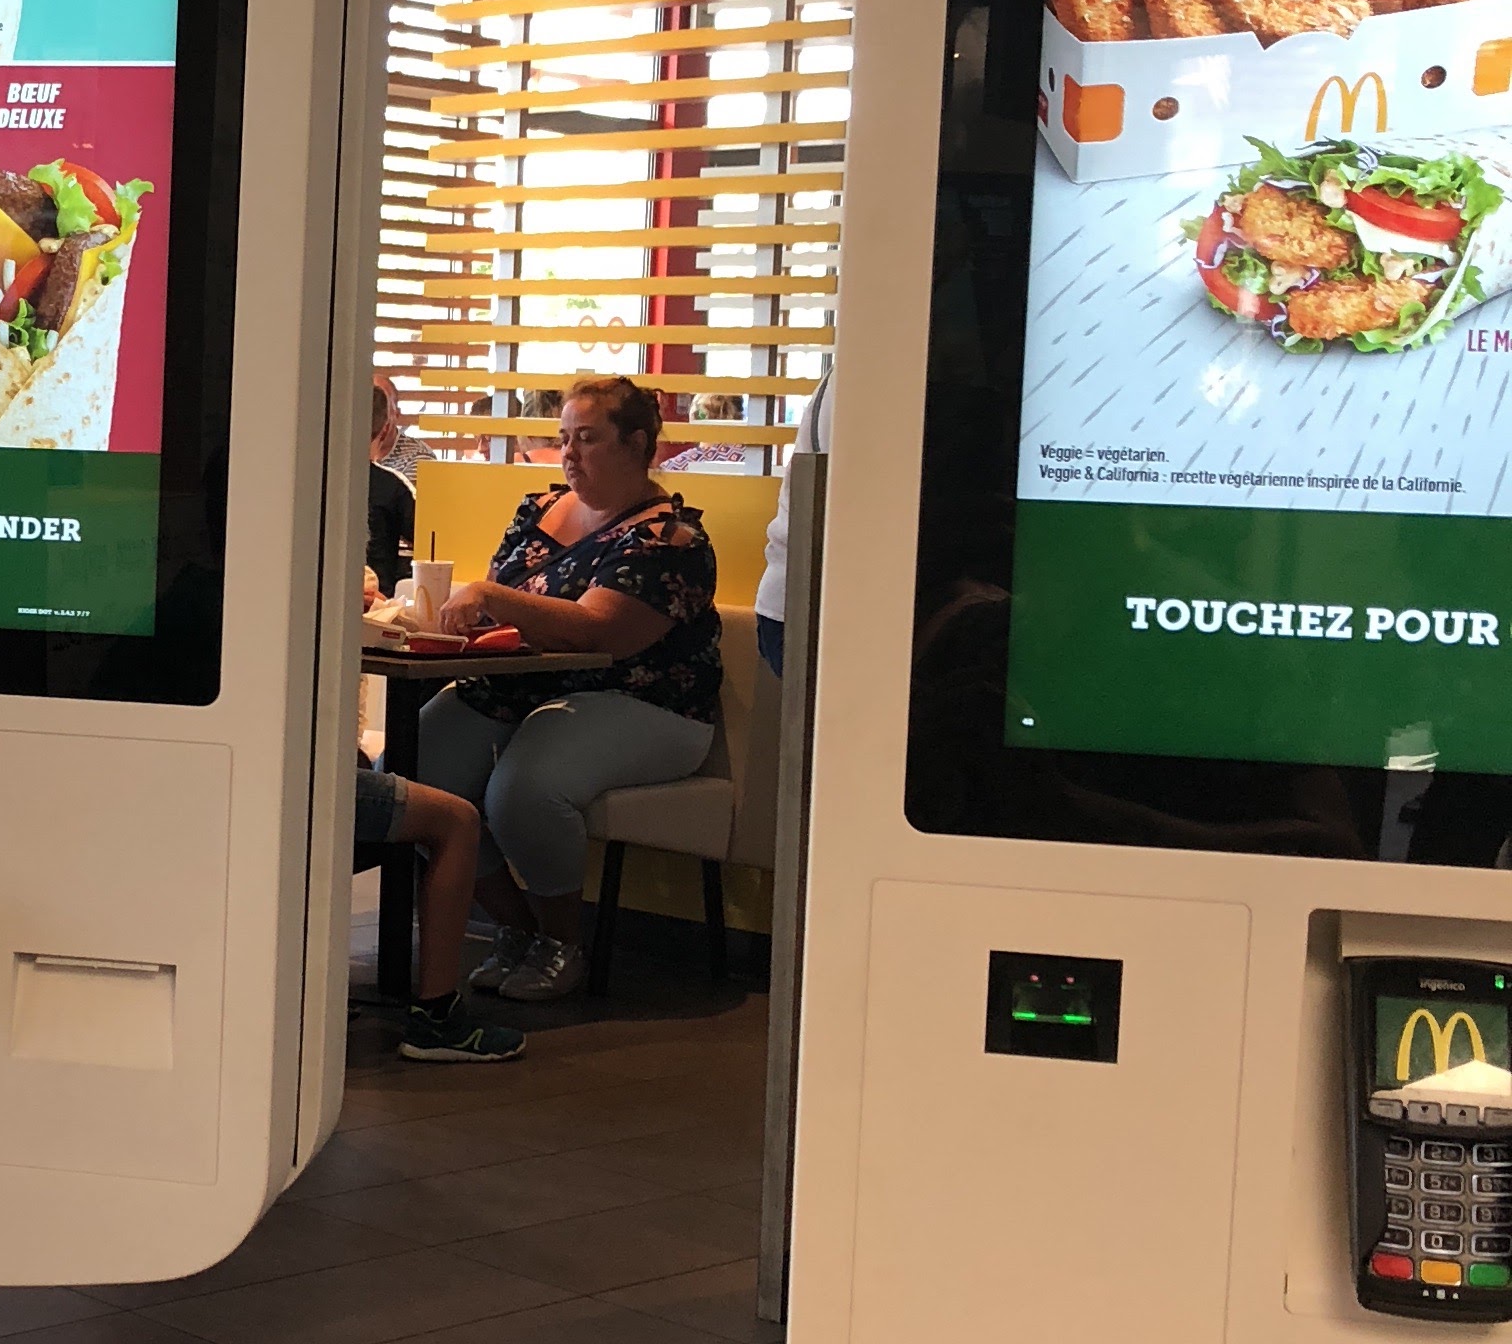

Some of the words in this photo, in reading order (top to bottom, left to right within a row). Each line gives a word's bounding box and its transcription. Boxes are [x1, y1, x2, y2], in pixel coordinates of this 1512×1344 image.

[7, 82, 62, 104] BŒUF
[1467, 329, 1488, 352] LE
[1494, 329, 1512, 352] M
[1040, 444, 1082, 462] Veggie
[1097, 446, 1169, 464] végétarien.
[1040, 464, 1081, 482] Veggie
[1084, 466, 1094, 480] &
[1097, 465, 1159, 482] California
[1171, 470, 1216, 484] recette
[1219, 469, 1304, 488] végétarienne
[1307, 472, 1359, 492] inspirée
[1363, 475, 1379, 490] de
[1382, 475, 1393, 491] la
[1397, 476, 1466, 493] Californie.
[1125, 596, 1353, 639] TOUCHEZ
[1365, 607, 1500, 646] POUR
